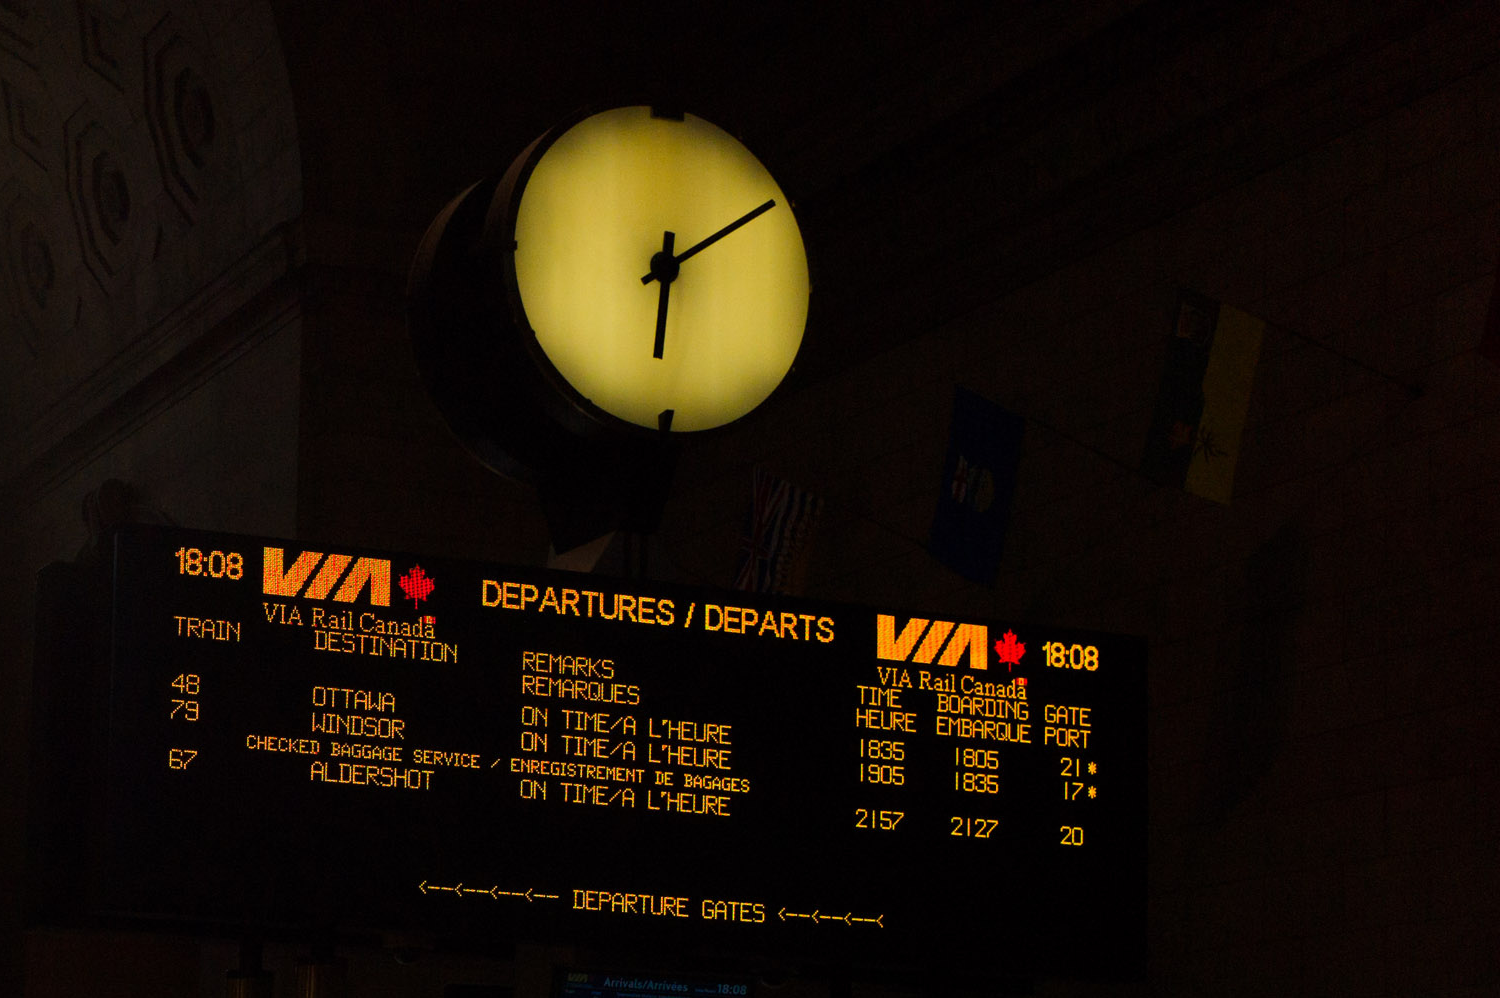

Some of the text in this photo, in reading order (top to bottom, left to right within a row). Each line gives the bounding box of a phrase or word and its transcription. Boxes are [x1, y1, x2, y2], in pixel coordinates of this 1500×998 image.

[175, 547, 243, 580] 18:08
[263, 547, 391, 606] VIA
[263, 602, 436, 639] VIA Rail Canada
[482, 580, 675, 626] DEPARTURES
[705, 604, 834, 643] DEPARTS
[174, 616, 240, 641] TRAIN
[877, 614, 988, 670] VIA
[315, 630, 457, 663] DESTINATION
[1042, 641, 1099, 671] 18:08
[523, 651, 614, 679] REMARKS
[172, 674, 200, 694] 48
[522, 675, 640, 705] REMARQUES
[857, 685, 902, 708] TIME
[877, 666, 1027, 700] VIA Rail Canada
[171, 699, 199, 721] 79
[313, 686, 395, 712] OTTAWA
[937, 693, 1029, 721] BOARDING
[312, 712, 405, 739] WINDSOR
[522, 706, 731, 744] ON TIME/A L'HEURE
[856, 708, 916, 732] HEURE
[937, 716, 1031, 743] EMBARQUE
[1045, 705, 1091, 727] GATE
[521, 732, 731, 770] ON TIME/A L'HEURE
[861, 739, 904, 761] 1835
[1045, 727, 1091, 748] PORT
[169, 749, 197, 769] 67
[247, 735, 320, 754] CHECKED
[331, 742, 402, 761] BAGGAGE
[414, 749, 480, 768] SERVICE
[511, 758, 645, 783] ENREGISTREMENT
[655, 771, 673, 786] DE
[684, 774, 750, 793] BAGAGES
[956, 748, 999, 769] 1805
[311, 761, 434, 789] ALDERSHOT
[861, 764, 904, 785] 1905
[956, 772, 998, 793] 1835
[520, 779, 730, 816] ON TIME/A L'HEURE
[856, 809, 904, 830] 2157
[951, 817, 998, 838] 2127
[1060, 826, 1083, 846] 20
[573, 890, 765, 923] DEPARTURE GATES
[604, 976, 689, 993] Arrivals/Arrivées
[716, 984, 748, 996] 18:08
